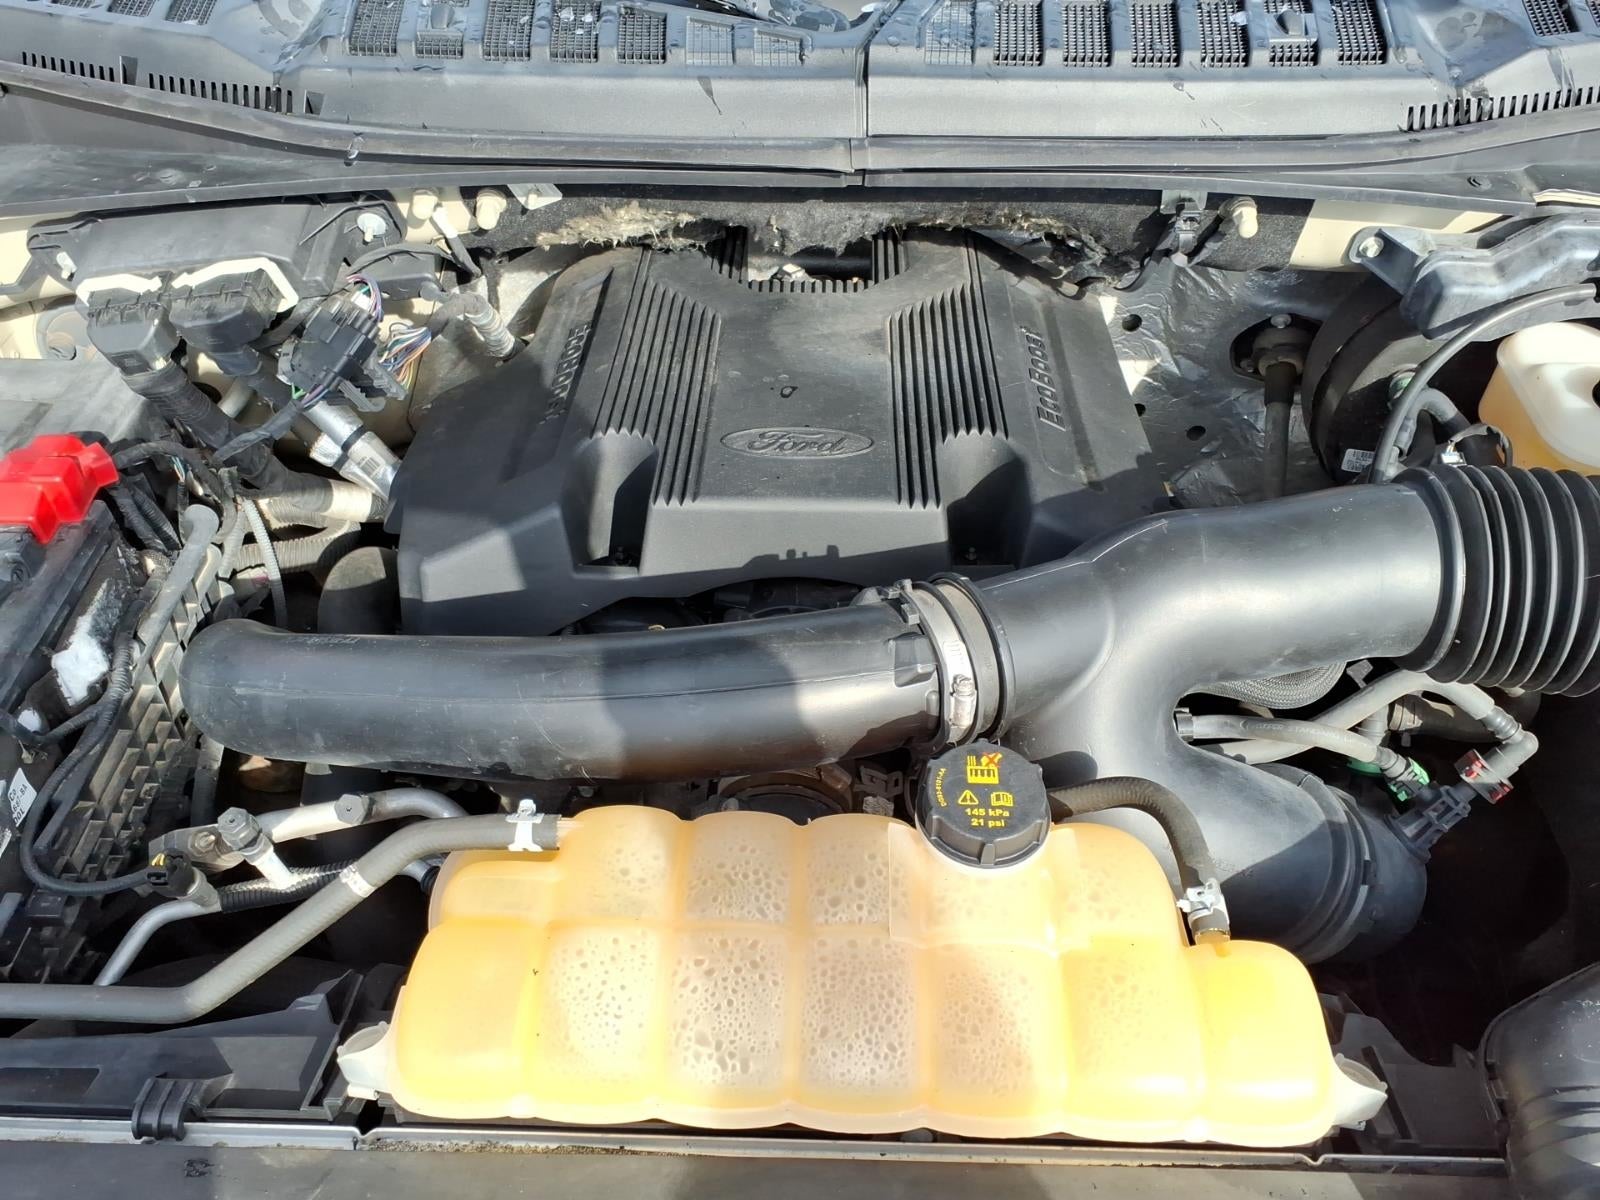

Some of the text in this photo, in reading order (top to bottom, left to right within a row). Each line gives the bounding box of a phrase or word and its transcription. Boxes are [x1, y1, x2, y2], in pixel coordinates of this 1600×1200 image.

[1019, 325, 1067, 432] EcoBoost
[747, 430, 849, 454] Ford
[965, 807, 1010, 817] 145 kPa
[970, 818, 1005, 828] 21 psi
